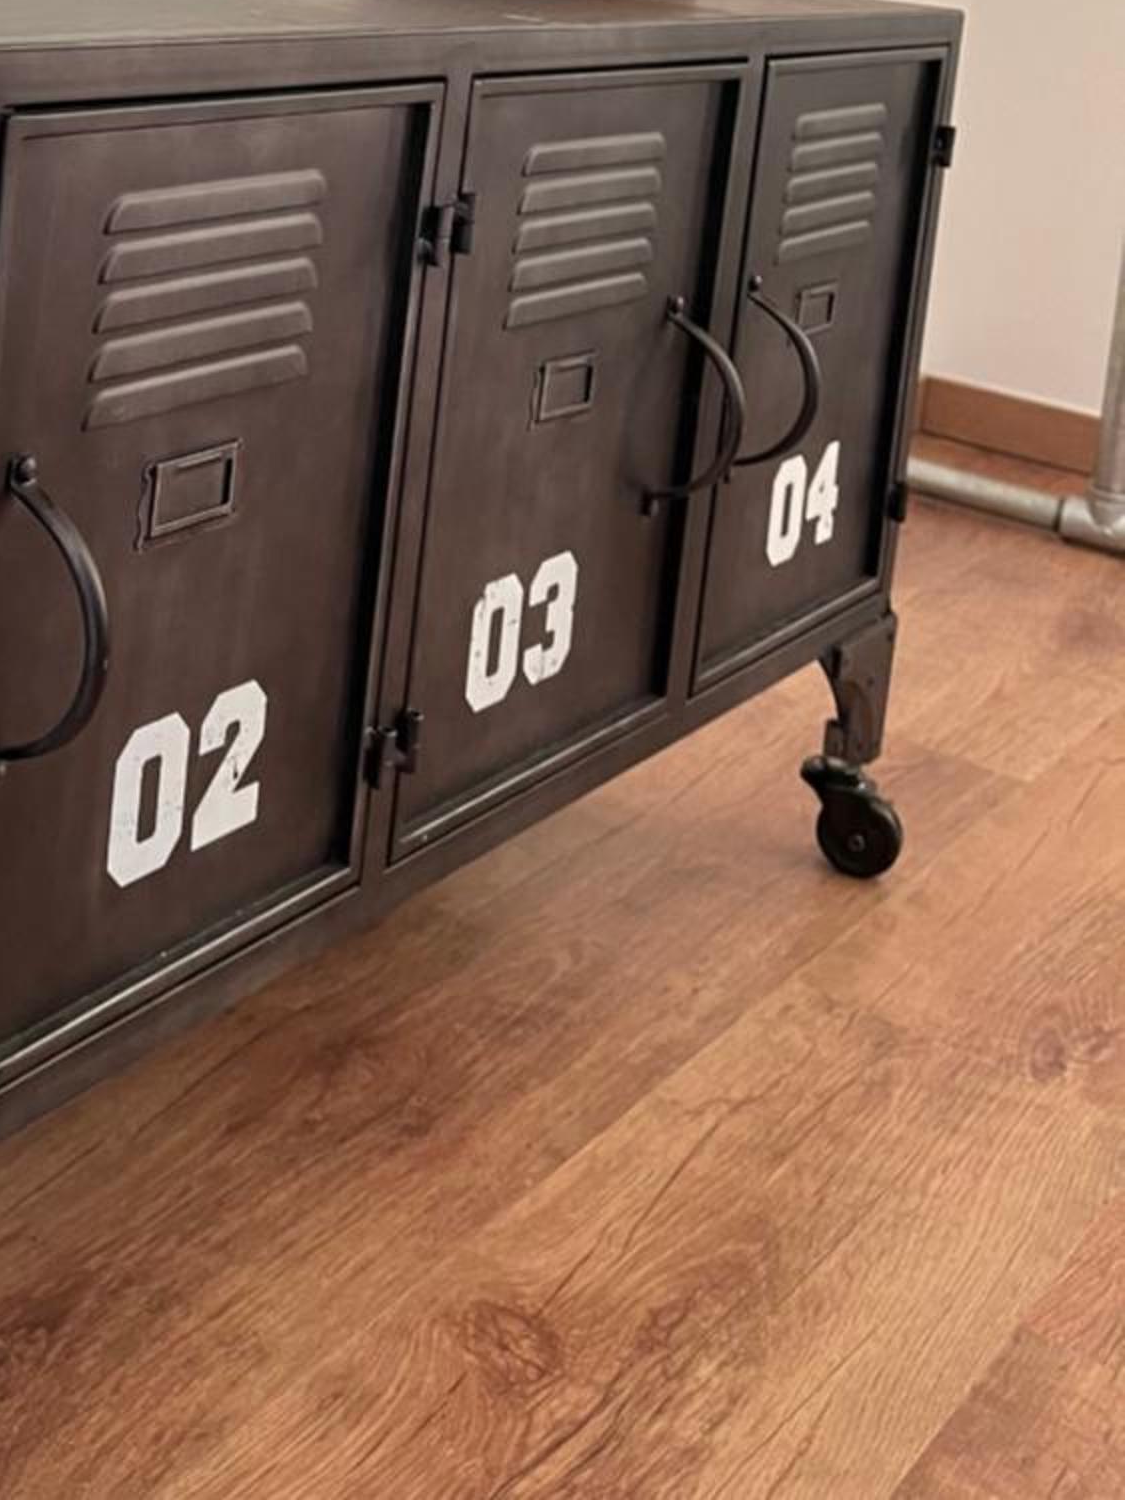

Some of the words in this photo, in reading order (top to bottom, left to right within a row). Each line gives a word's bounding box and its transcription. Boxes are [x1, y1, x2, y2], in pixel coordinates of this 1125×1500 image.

[766, 441, 841, 567] 04
[465, 551, 579, 713] 03
[106, 680, 268, 888] 02
